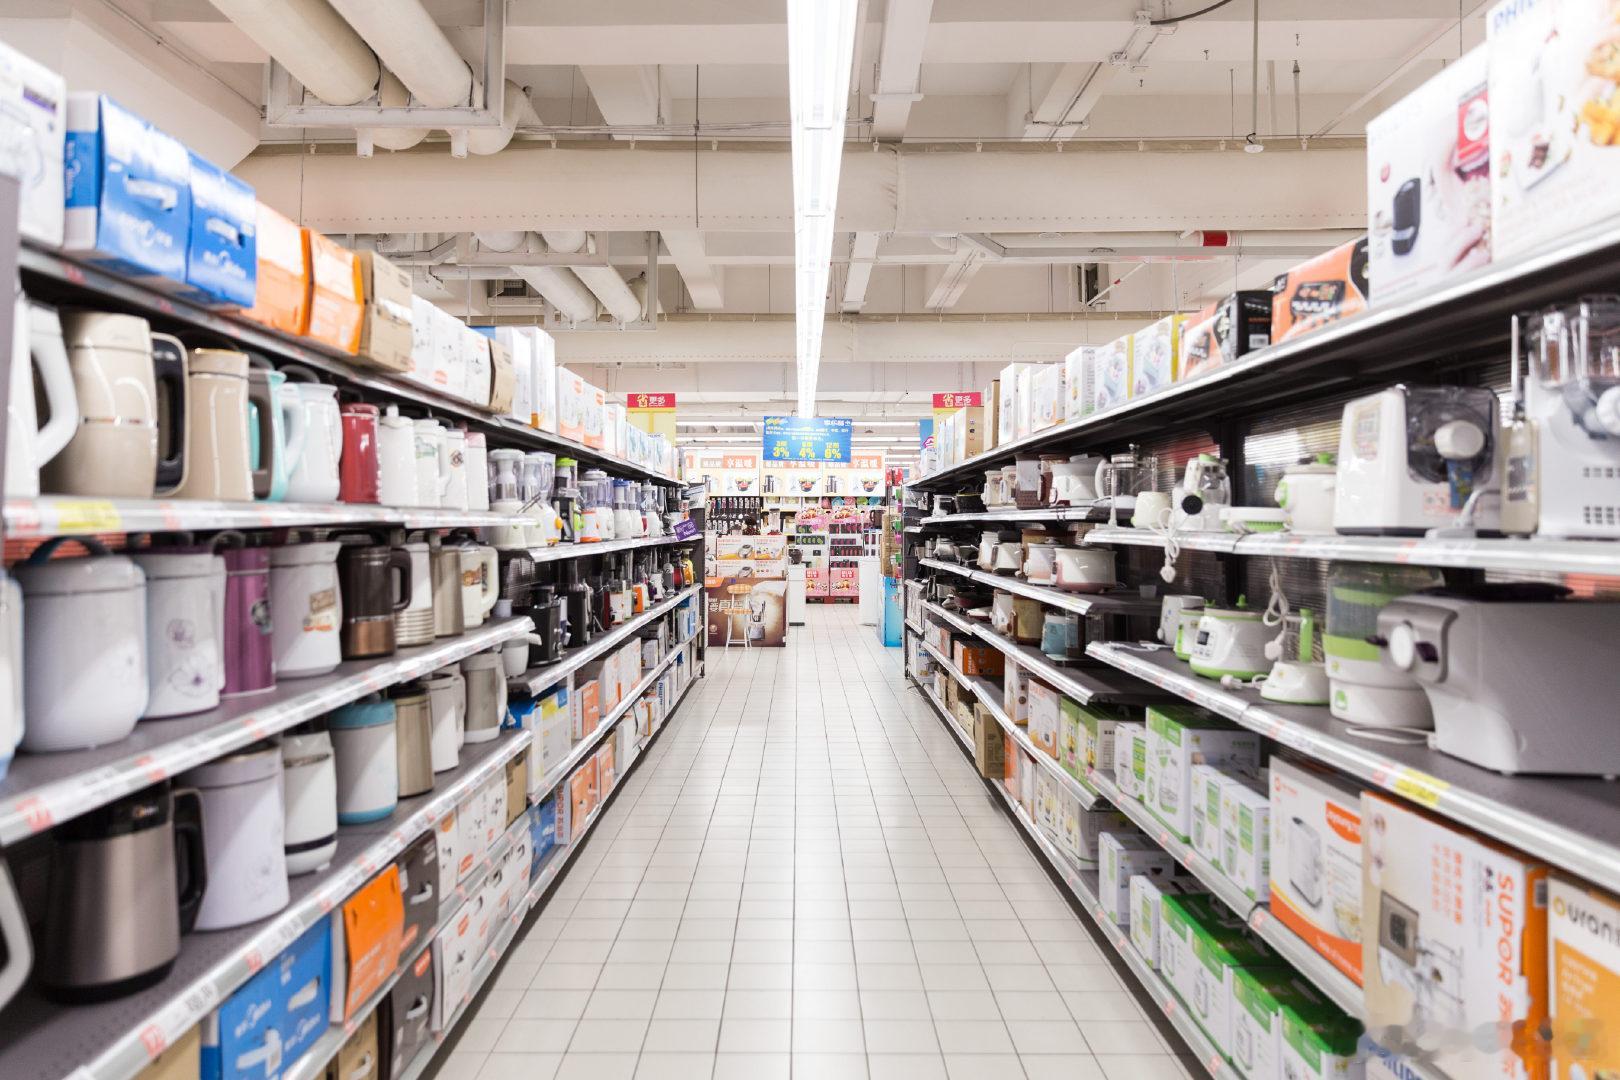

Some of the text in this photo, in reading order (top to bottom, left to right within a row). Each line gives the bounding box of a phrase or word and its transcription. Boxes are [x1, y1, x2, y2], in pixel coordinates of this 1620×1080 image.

[637, 393, 665, 408] 省更多
[943, 393, 971, 407] 省更多
[773, 447, 789, 457] 3%
[1497, 872, 1516, 986] SUPOR
